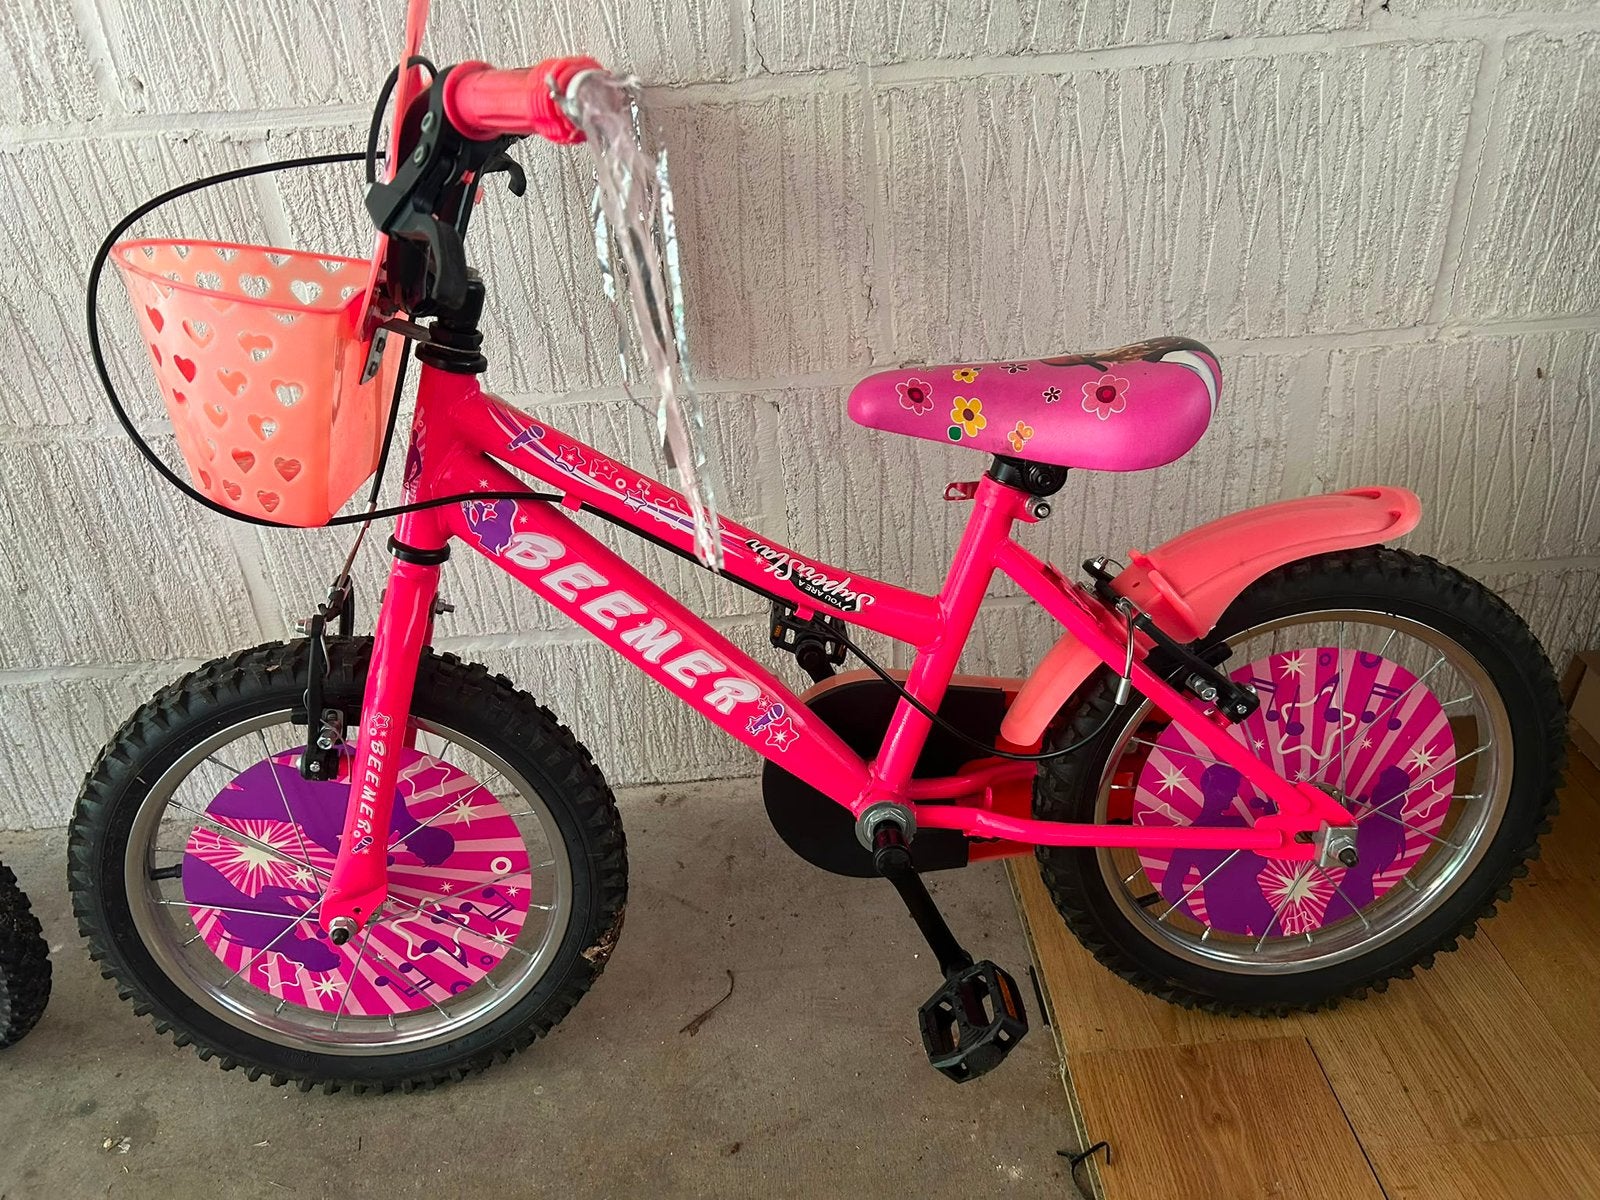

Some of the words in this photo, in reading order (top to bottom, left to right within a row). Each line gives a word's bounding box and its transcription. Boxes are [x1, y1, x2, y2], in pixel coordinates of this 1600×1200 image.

[798, 579, 805, 587] A
[804, 583, 824, 597] ARE
[824, 594, 842, 608] YOU
[503, 532, 762, 715] BEEMER
[357, 740, 386, 834] BEEMER
